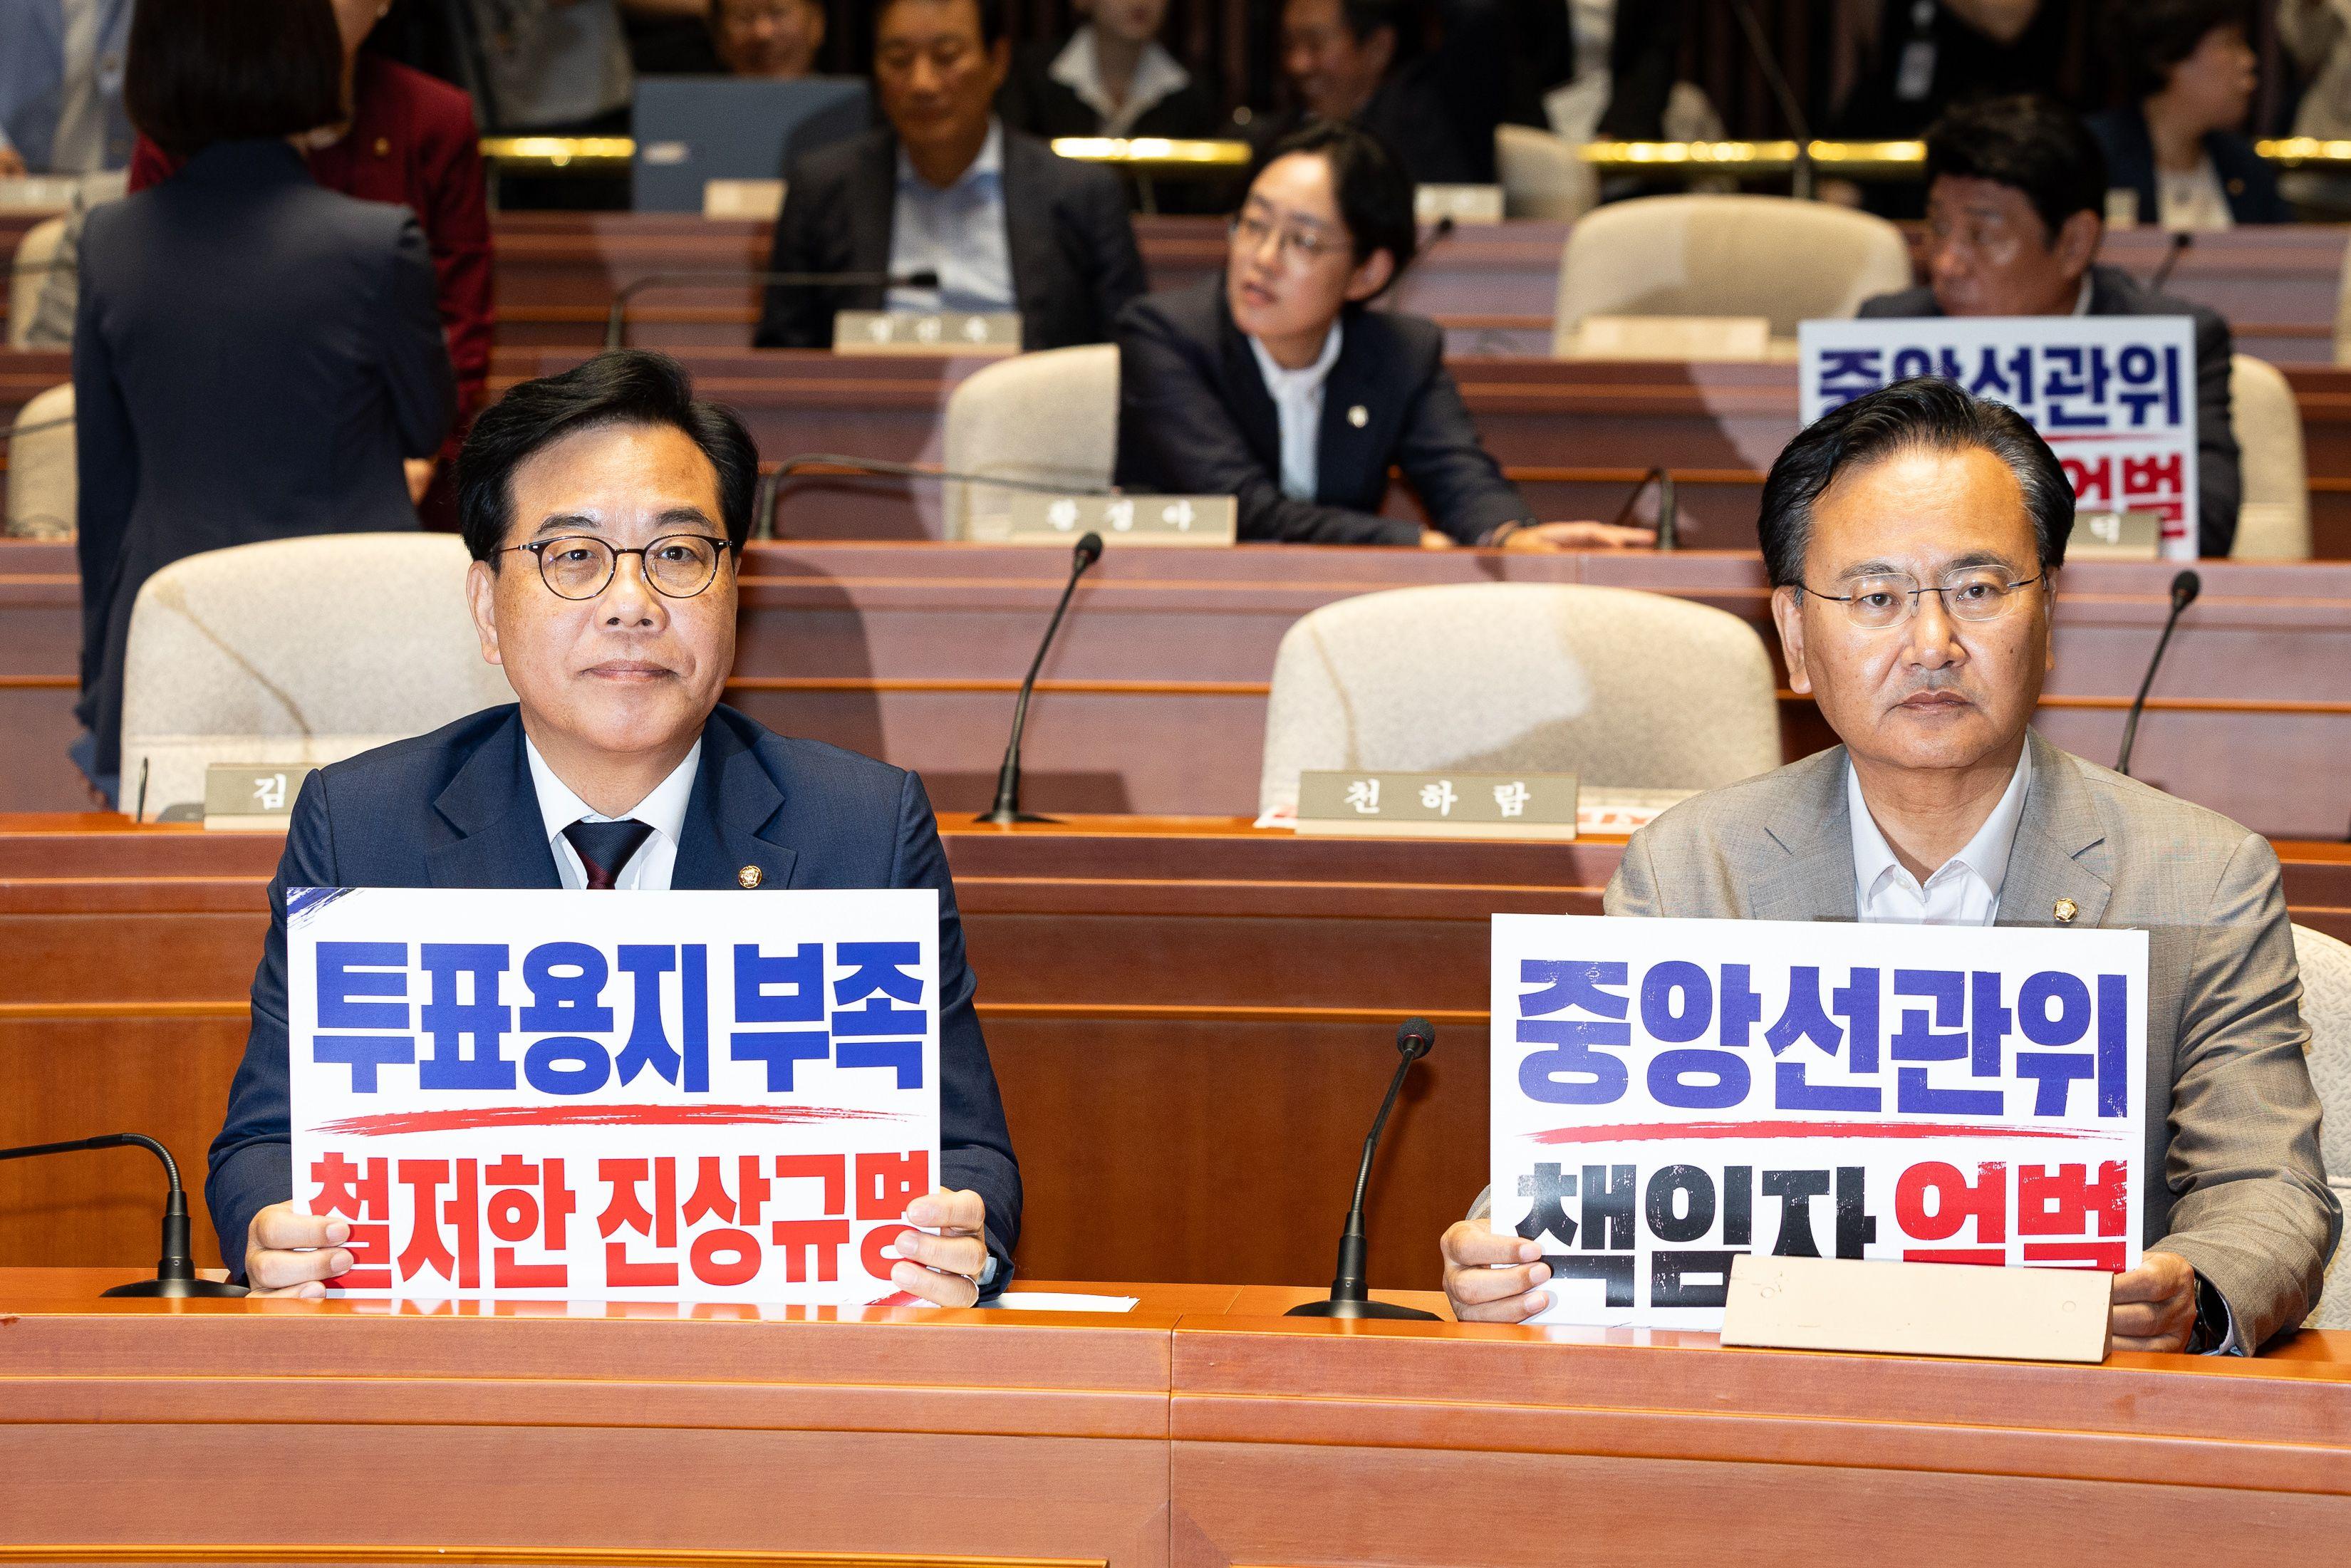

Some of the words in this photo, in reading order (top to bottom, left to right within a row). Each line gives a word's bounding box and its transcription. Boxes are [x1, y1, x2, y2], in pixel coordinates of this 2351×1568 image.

[312, 941, 710, 1096] 투표용지
[730, 941, 928, 1094] 부족
[1515, 958, 2128, 1118] 중앙선관위
[309, 1151, 576, 1289] 철저한
[597, 1149, 929, 1287] 진상규명
[1515, 1161, 1877, 1308] 책임자
